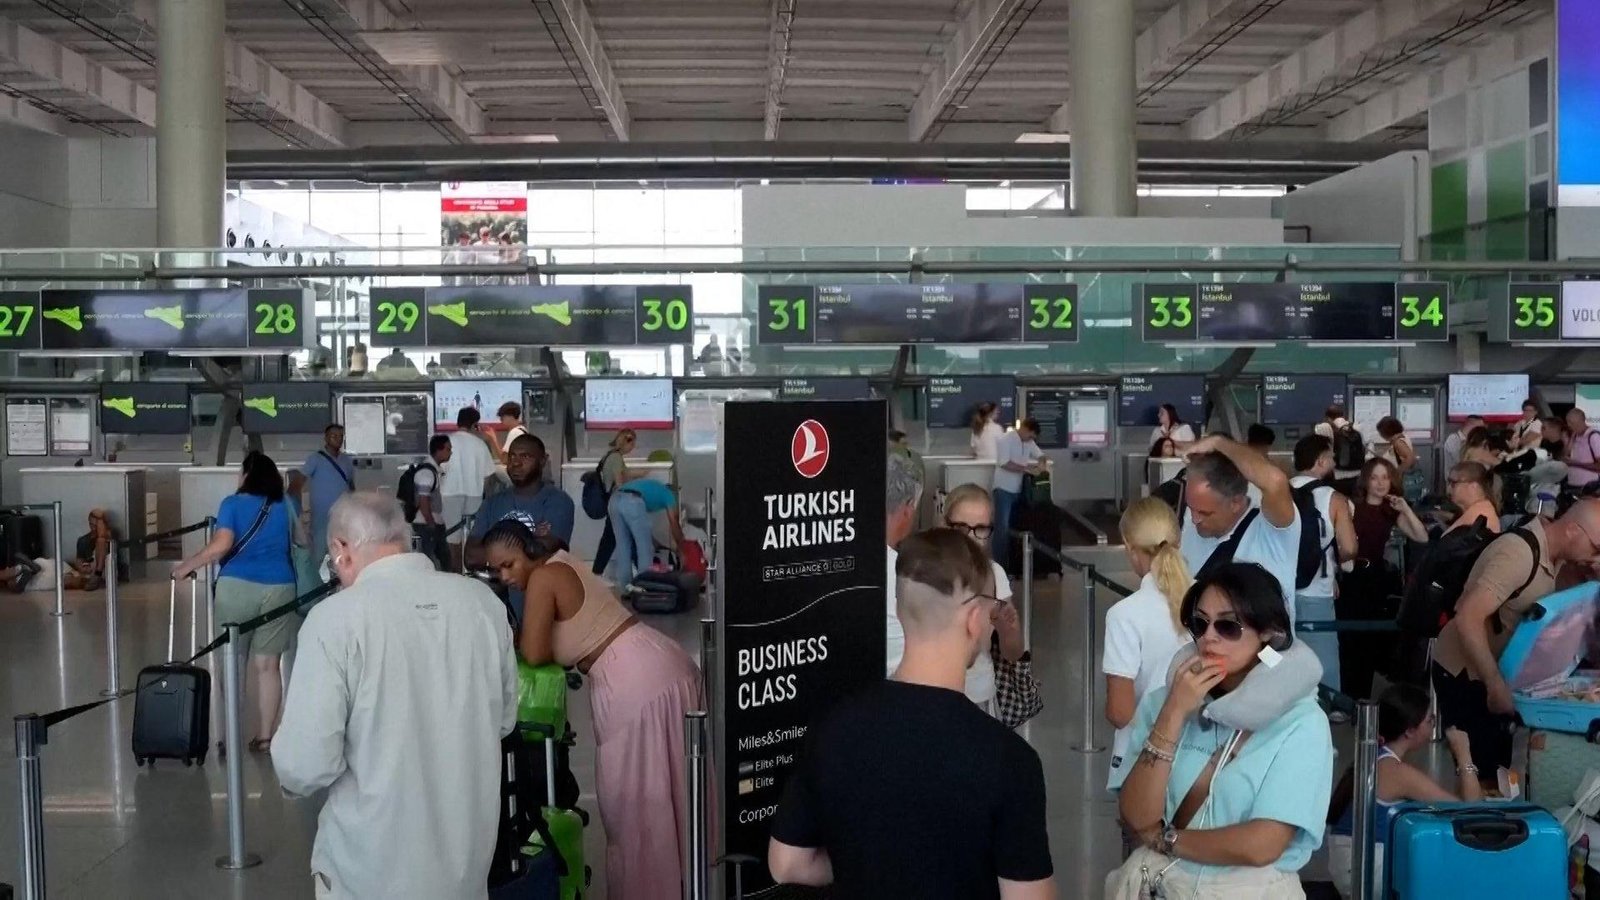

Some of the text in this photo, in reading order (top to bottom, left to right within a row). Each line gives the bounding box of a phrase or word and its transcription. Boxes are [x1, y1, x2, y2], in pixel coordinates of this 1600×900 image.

[0, 306, 34, 336] 27
[255, 304, 296, 334] 28
[377, 302, 419, 333] 29
[642, 299, 688, 331] 30
[768, 299, 806, 330] 31
[1030, 298, 1072, 329] 32
[1150, 297, 1192, 327] 33
[1400, 296, 1443, 327] 34
[1514, 297, 1555, 327] 35
[763, 489, 855, 520] TURKISH
[762, 518, 856, 550] AIRLINES
[765, 568, 784, 578] STAR
[786, 563, 821, 575] ALLIANCE
[738, 635, 828, 676] BUSINESS
[738, 674, 797, 710] CLASS
[755, 754, 793, 772] Elite Plus
[755, 776, 774, 789] Elite
[738, 804, 779, 824] Corpor
